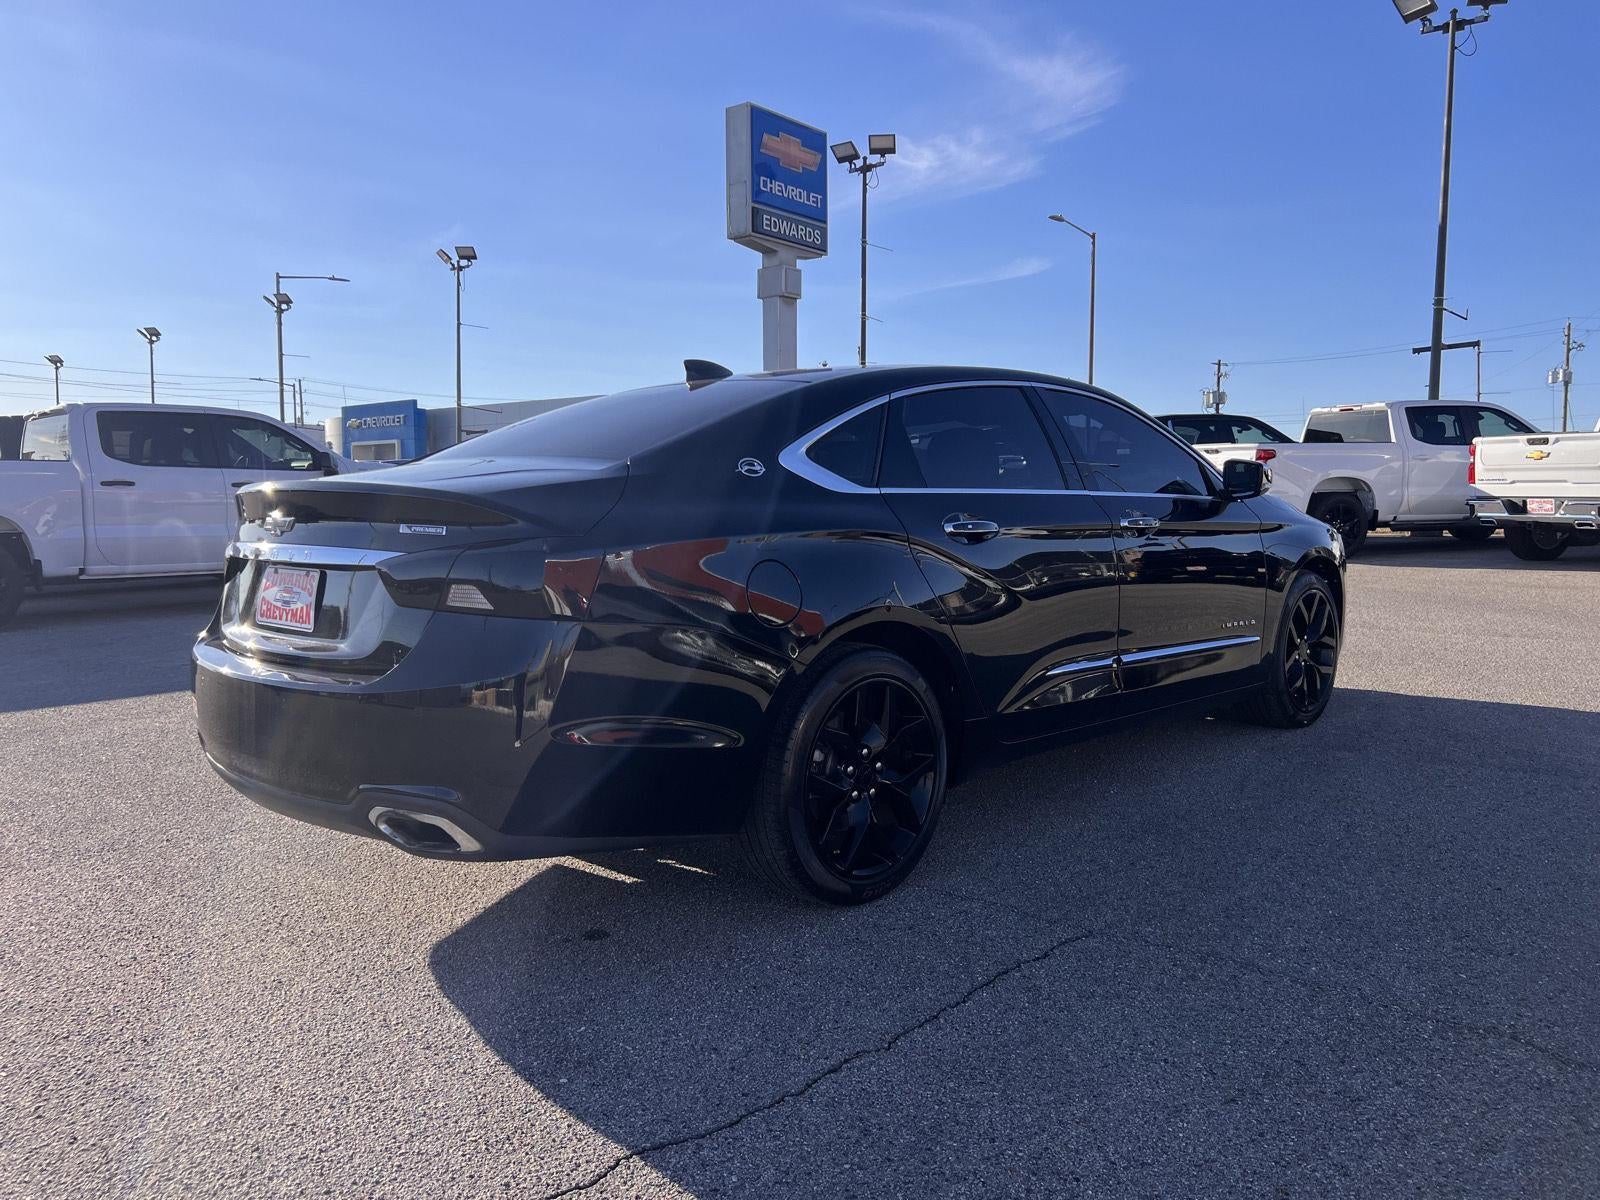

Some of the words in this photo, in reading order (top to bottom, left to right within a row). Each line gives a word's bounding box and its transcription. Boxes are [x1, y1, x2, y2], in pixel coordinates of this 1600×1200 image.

[759, 176, 822, 208] CHEVROLET
[762, 214, 821, 245] EDWARDS
[361, 414, 405, 428] CHEVROLET
[259, 595, 312, 625] CHEVYMAN
